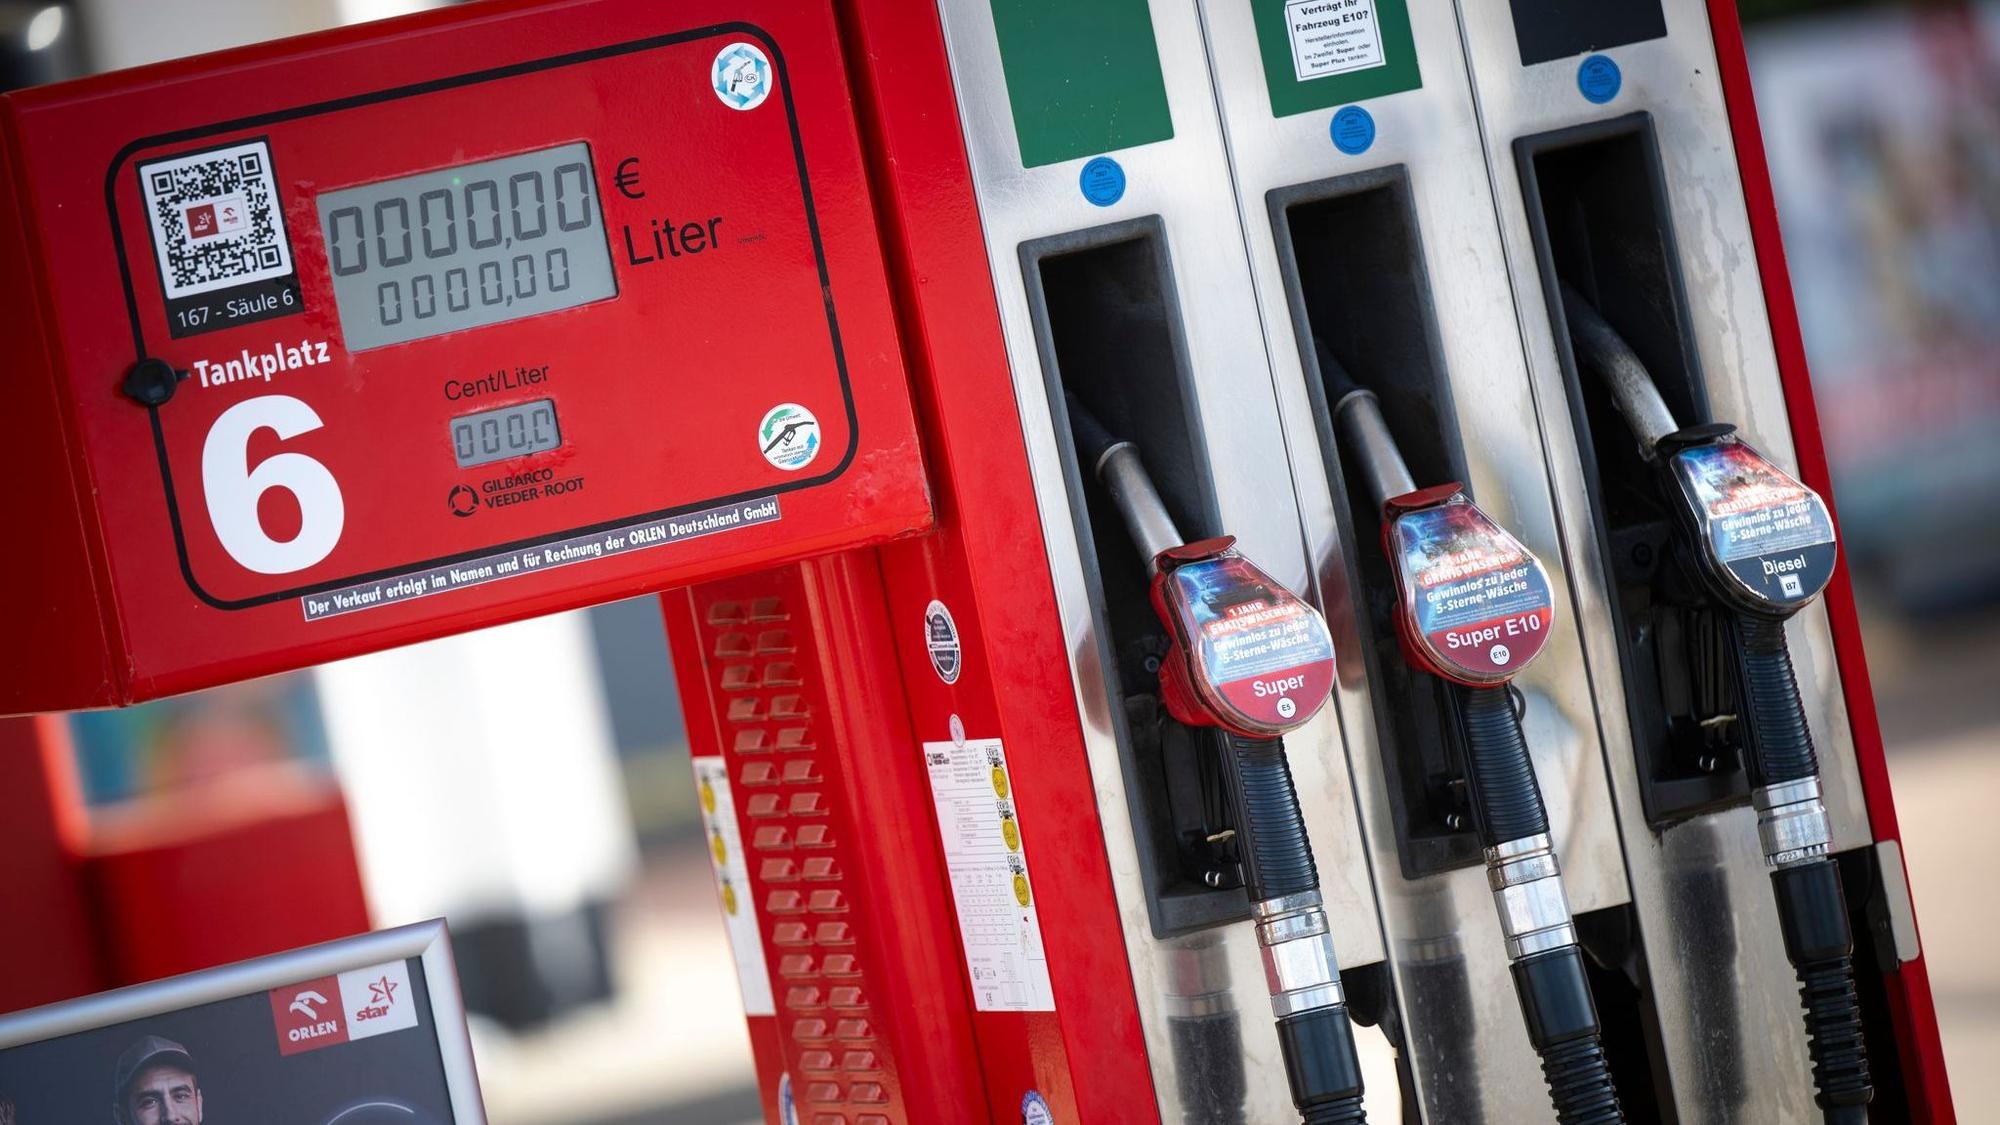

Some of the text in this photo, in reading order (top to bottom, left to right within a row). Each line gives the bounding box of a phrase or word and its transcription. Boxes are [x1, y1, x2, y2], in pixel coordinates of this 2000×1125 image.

[1295, 10, 1368, 32] Fahrzeug E10?
[1301, 1, 1342, 15] Verträgt
[1337, 46, 1355, 54] Super
[614, 157, 645, 199] €
[623, 216, 723, 266] Liter
[177, 306, 210, 328] 167
[227, 292, 278, 318] Säule
[282, 289, 294, 307] 6
[194, 339, 331, 388] Tankplatz
[444, 365, 549, 401] Cent/Liter
[202, 394, 345, 575] 6
[482, 468, 554, 494] GILBARCO
[484, 477, 585, 509] VEEDER-ROOT
[1721, 511, 1771, 530] Gewinnlos
[1786, 502, 1811, 516] jeder
[308, 502, 777, 616] Der Verkauf erfolgt im Namen und für Rechnung der ORLEN Deutschland GmbH
[1763, 554, 1807, 575] Diesel
[1426, 567, 1528, 602] Gewinnlos zu jeder
[1436, 581, 1527, 614] 5-Sterne-Wäsche
[1785, 582, 1797, 590] B7
[1238, 602, 1265, 615] JAHR
[1213, 619, 1310, 652] Gewinnlos zu jeder
[1446, 625, 1501, 649] Super
[1505, 614, 1540, 637] E10
[1253, 674, 1305, 697] Super
[356, 1005, 389, 1022] star
[288, 1020, 338, 1042] ORLEN
